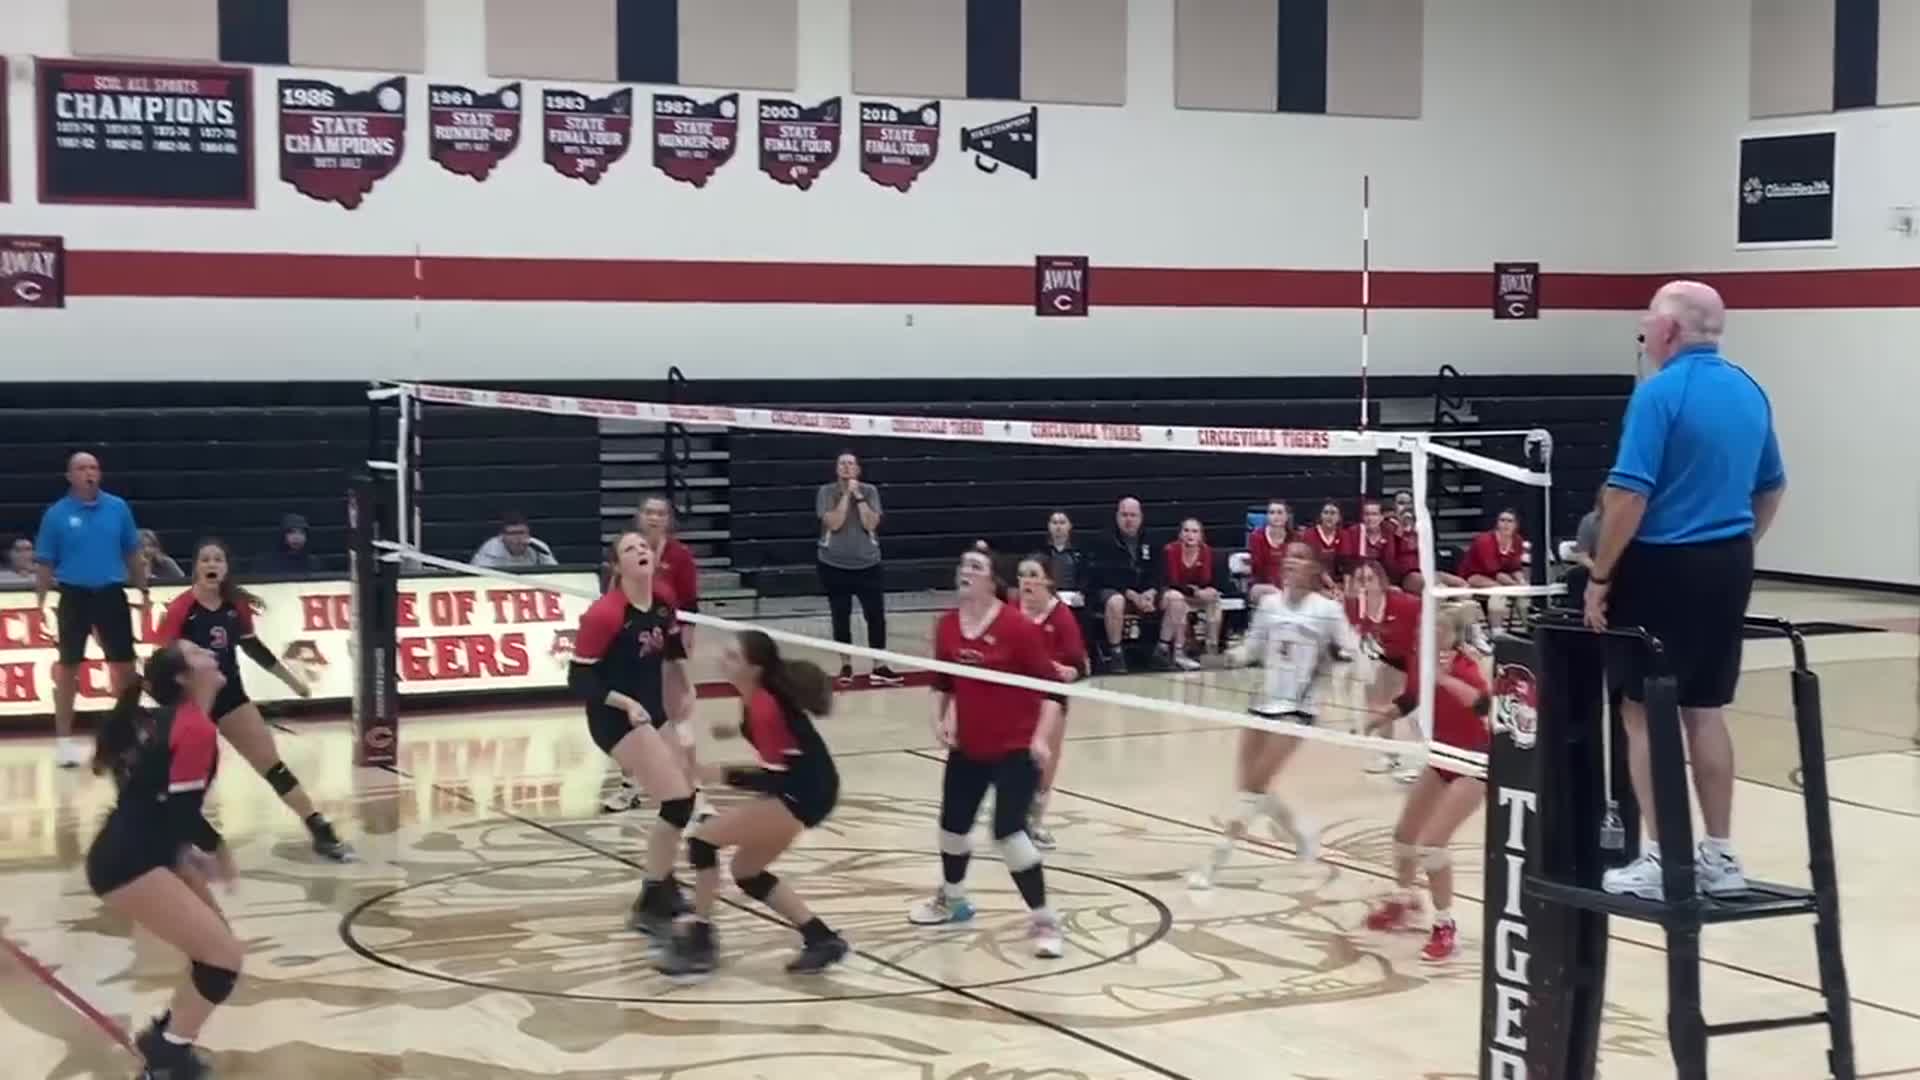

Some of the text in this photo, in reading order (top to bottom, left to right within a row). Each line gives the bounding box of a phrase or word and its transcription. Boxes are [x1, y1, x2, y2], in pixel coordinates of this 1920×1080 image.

[154, 78, 199, 95] SPORTS
[282, 87, 335, 107] 1986
[546, 96, 586, 111] 1983
[56, 92, 234, 125] CHAMPIONS
[760, 105, 799, 120] 2003
[862, 107, 898, 121] 2018
[310, 116, 369, 135] STATE
[450, 111, 495, 127] STATE
[565, 116, 606, 132] STATE
[435, 125, 513, 142] RUNNER-UP
[674, 121, 713, 136] STATE
[779, 125, 818, 140] STATE
[880, 127, 915, 141] STATE
[285, 134, 395, 156] CHAMPIONS
[550, 129, 623, 146] FINAL FOUR
[658, 133, 730, 151] RUNNER-UP
[764, 137, 832, 154] FINAL FOUR
[865, 140, 930, 156] FINAL FOUR
[0, 251, 55, 279] AWAY
[1042, 269, 1083, 292] AWAY
[1499, 274, 1534, 296] AWAY
[1030, 423, 1142, 442] CIRCLEVILLE TIGERS
[1198, 429, 1330, 449] CIRCLEVILLE TIGERS
[299, 588, 564, 631] HOE OF THE
[209, 625, 228, 647] 3
[399, 633, 529, 681] GERS
